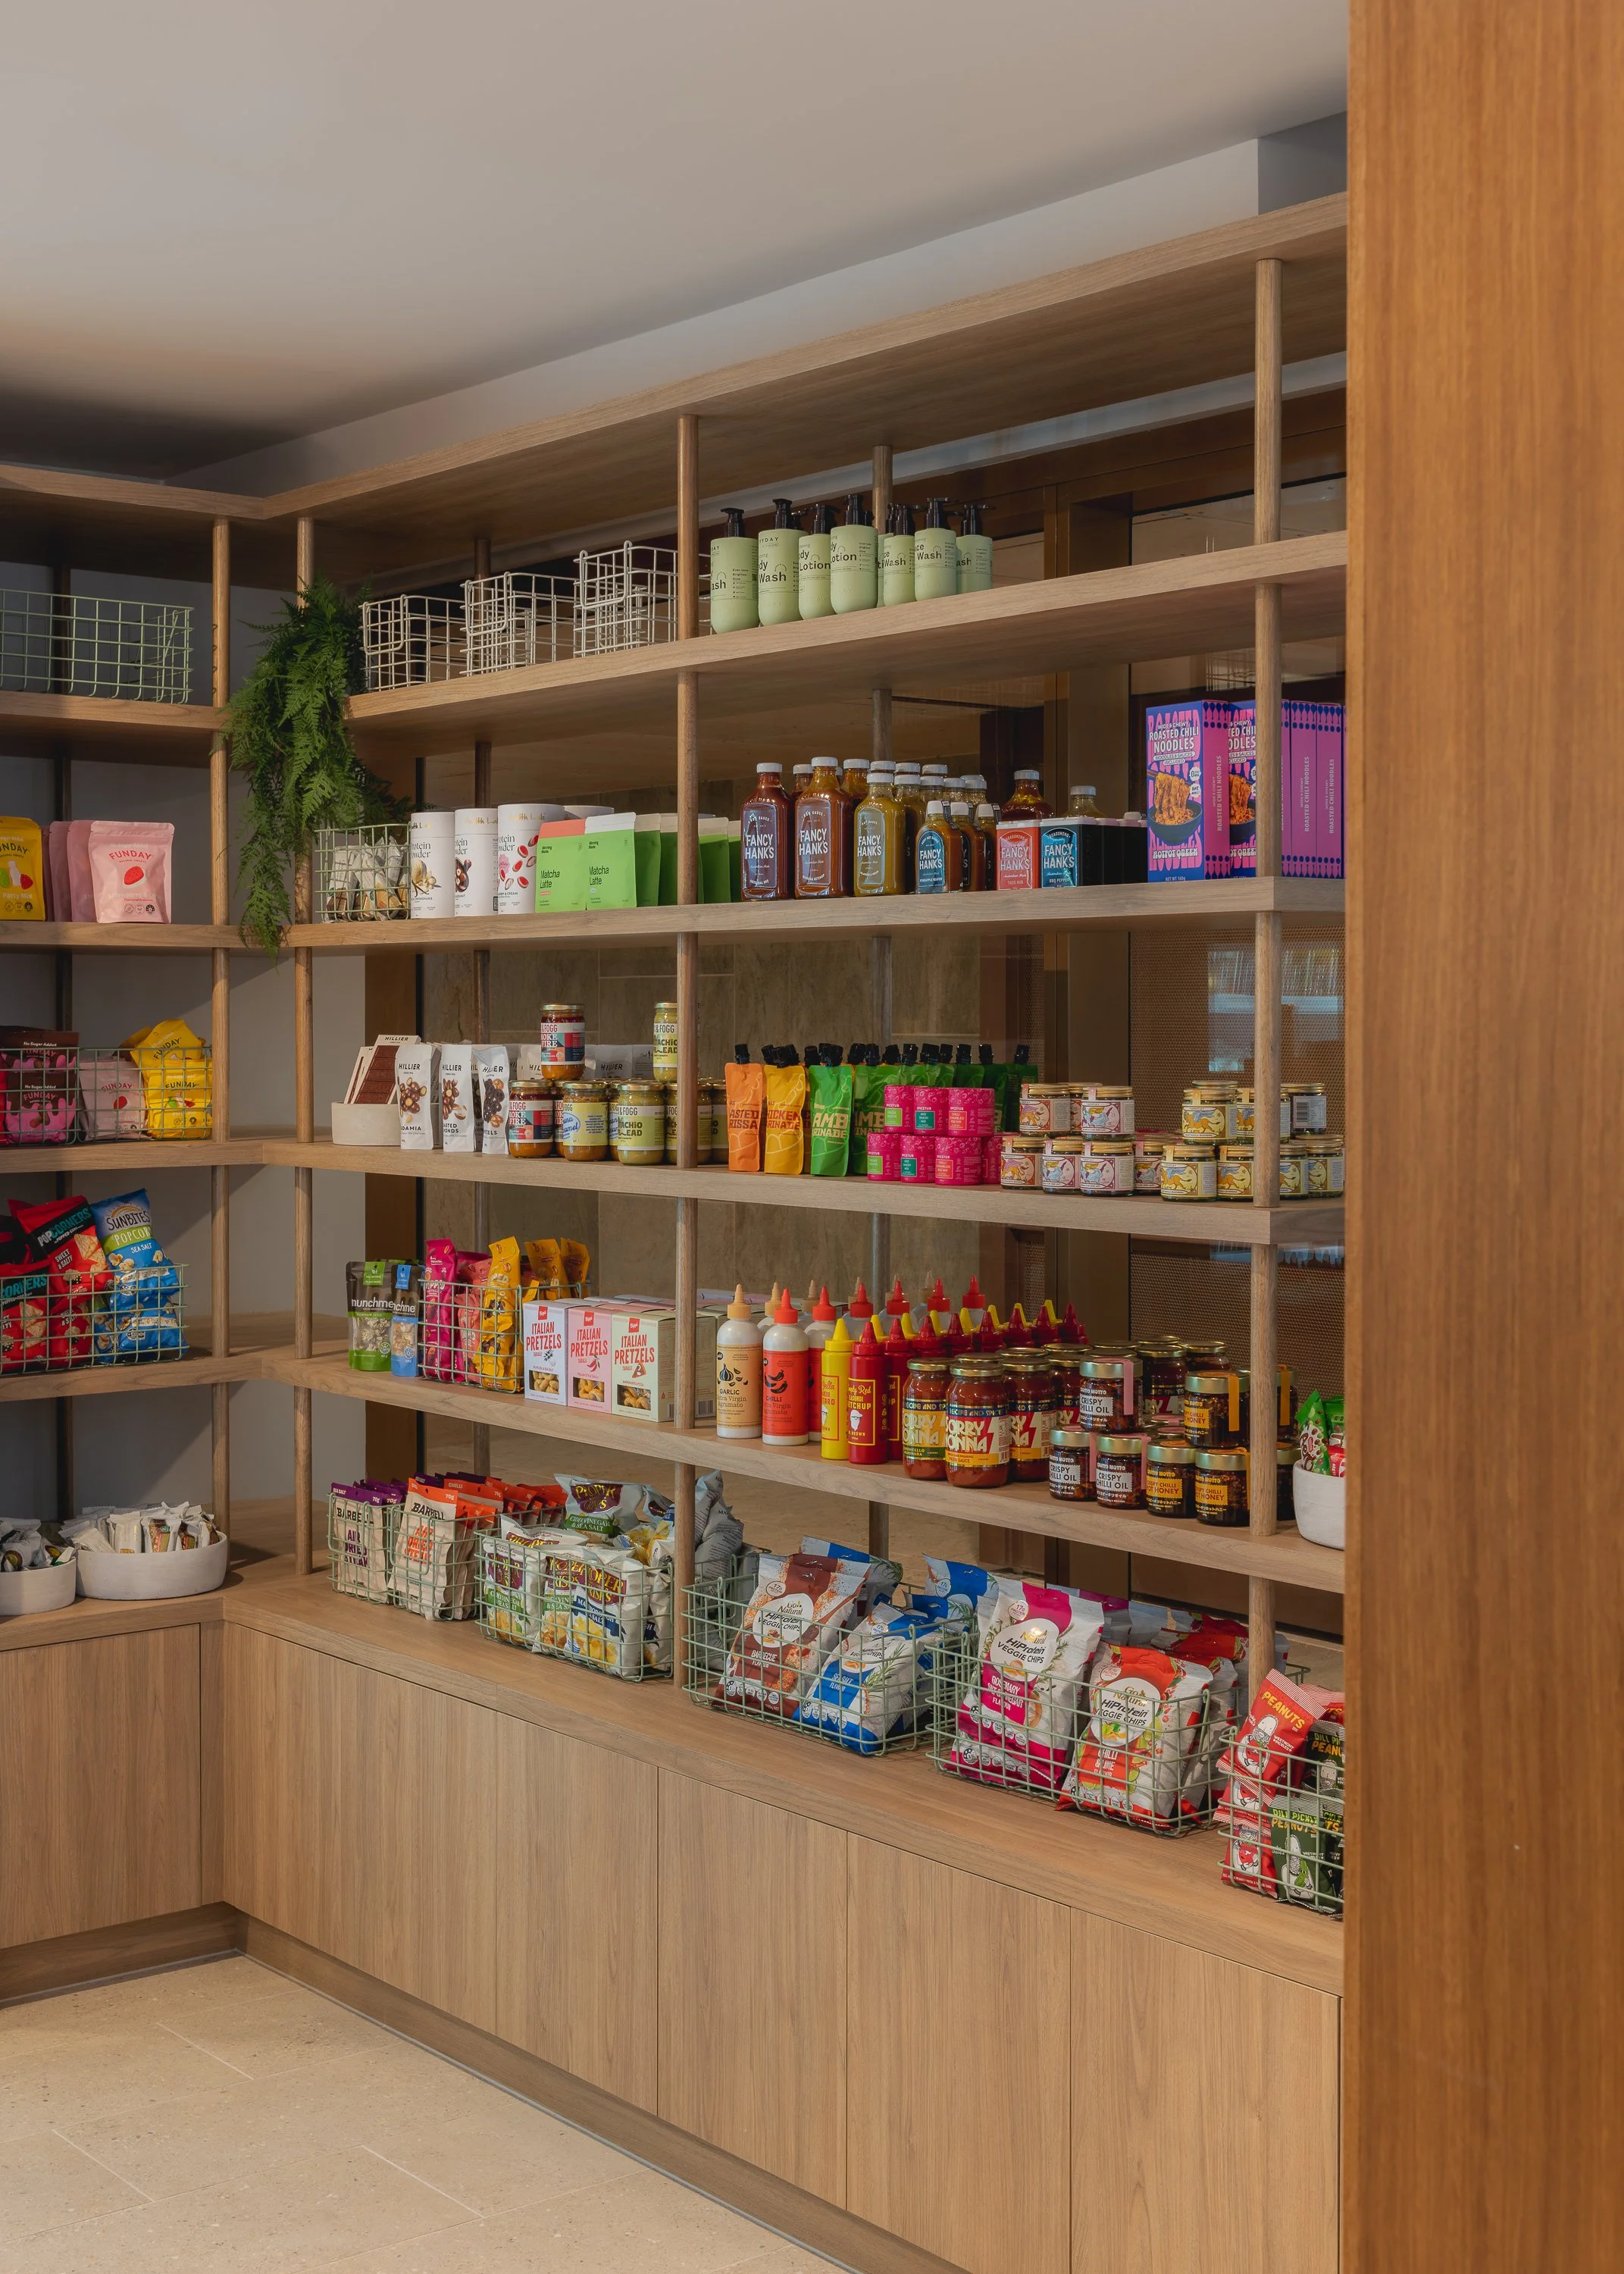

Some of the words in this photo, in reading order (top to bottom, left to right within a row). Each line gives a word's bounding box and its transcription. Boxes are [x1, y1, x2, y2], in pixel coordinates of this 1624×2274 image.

[884, 557, 906, 567] Wash
[917, 551, 942, 561] Wash
[799, 560, 831, 572] Lotion
[759, 572, 787, 584] Wash
[1149, 729, 1179, 741] ROASTED
[1180, 726, 1199, 738] CHILI
[1153, 737, 1195, 753] NOODLES
[746, 834, 774, 847] FANCY
[799, 828, 828, 842] FANCY
[858, 835, 881, 846] FANCY
[109, 850, 152, 860] FUNDAY
[745, 846, 774, 860] HANK'S
[799, 841, 828, 856] HANK'S
[857, 844, 882, 857] HANK'S
[919, 848, 941, 860] FANCY
[1001, 846, 1029, 860] FANCY
[1044, 843, 1073, 857] FANCY
[1153, 849, 1176, 860] HOTPOT
[1176, 847, 1198, 859] QUEEN
[919, 858, 943, 870] HANK'S
[1000, 858, 1030, 871] HANK'S
[1044, 855, 1075, 869] HANK'S
[540, 869, 560, 879] Matcha
[589, 866, 609, 875] Matcha
[540, 879, 552, 888] Latte
[589, 876, 602, 885] Latte
[659, 1025, 674, 1033] FOGG
[513, 1101, 526, 1110] FOGG
[623, 1107, 638, 1116] FOGG
[38, 1207, 92, 1248] POPCORNERS
[106, 1211, 150, 1231] SUNBITES
[130, 1245, 141, 1254] SEA
[141, 1242, 152, 1251] SALT
[55, 1249, 70, 1263] SWEET
[62, 1255, 73, 1268] SALTY
[532, 1321, 555, 1335] ITALIAN
[577, 1328, 601, 1341] ITALIAN
[526, 1334, 562, 1351] PRETZELS
[621, 1334, 647, 1348] ITALIAN
[571, 1340, 609, 1358] PRETZELS
[615, 1347, 655, 1365] PRETZELS
[858, 1385, 871, 1395] Red
[1081, 1396, 1103, 1406] CRISPY
[1050, 1464, 1070, 1474] CRISPY
[1098, 1472, 1122, 1482] CRISPY
[1154, 1486, 1179, 1494] HONEY
[1201, 1493, 1225, 1501] HONEY
[411, 1502, 446, 1521] BARBELL
[584, 1517, 611, 1527] VINEGAR
[778, 1605, 803, 1615] Natural
[783, 1624, 802, 1632] CHIPS
[997, 1641, 1027, 1661] VEGGIE
[1026, 1655, 1045, 1664] CHIPS
[1006, 1637, 1046, 1655] HiProtein
[1101, 1699, 1149, 1718] HiProtein
[1261, 1690, 1306, 1730] PEANUTS
[1123, 1715, 1147, 1727] CHIPS
[1314, 1732, 1330, 1743] DILL
[1098, 1747, 1118, 1761] CHILLI
